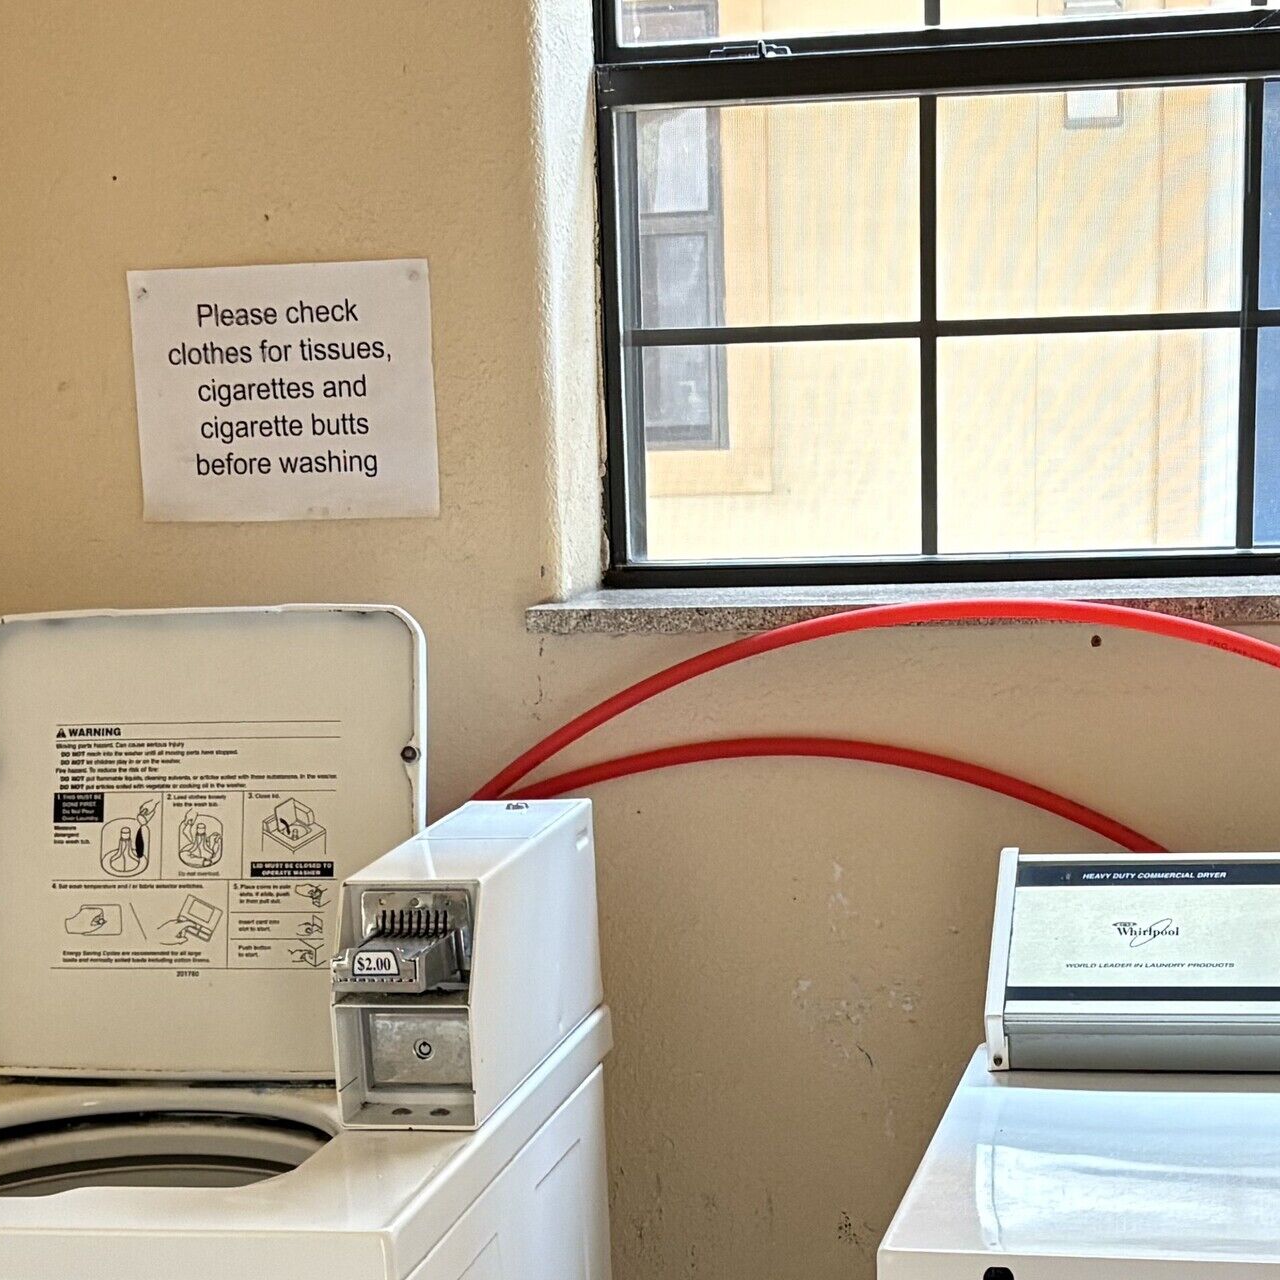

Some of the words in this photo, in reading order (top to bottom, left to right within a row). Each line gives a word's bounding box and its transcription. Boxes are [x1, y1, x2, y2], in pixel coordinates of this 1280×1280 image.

[197, 303, 277, 327] Please
[286, 298, 359, 324] check
[168, 342, 252, 365] clothes
[260, 339, 292, 363] for
[299, 338, 391, 362] tissues,
[198, 378, 315, 407] cigarettes
[323, 374, 367, 398] and
[200, 415, 303, 444] cigarette
[311, 413, 369, 436] butts
[196, 453, 271, 476] before
[279, 450, 378, 477] washing
[68, 727, 122, 737] WARNING
[1116, 926, 1180, 938] Whirlpool
[357, 956, 391, 972] $2.00
